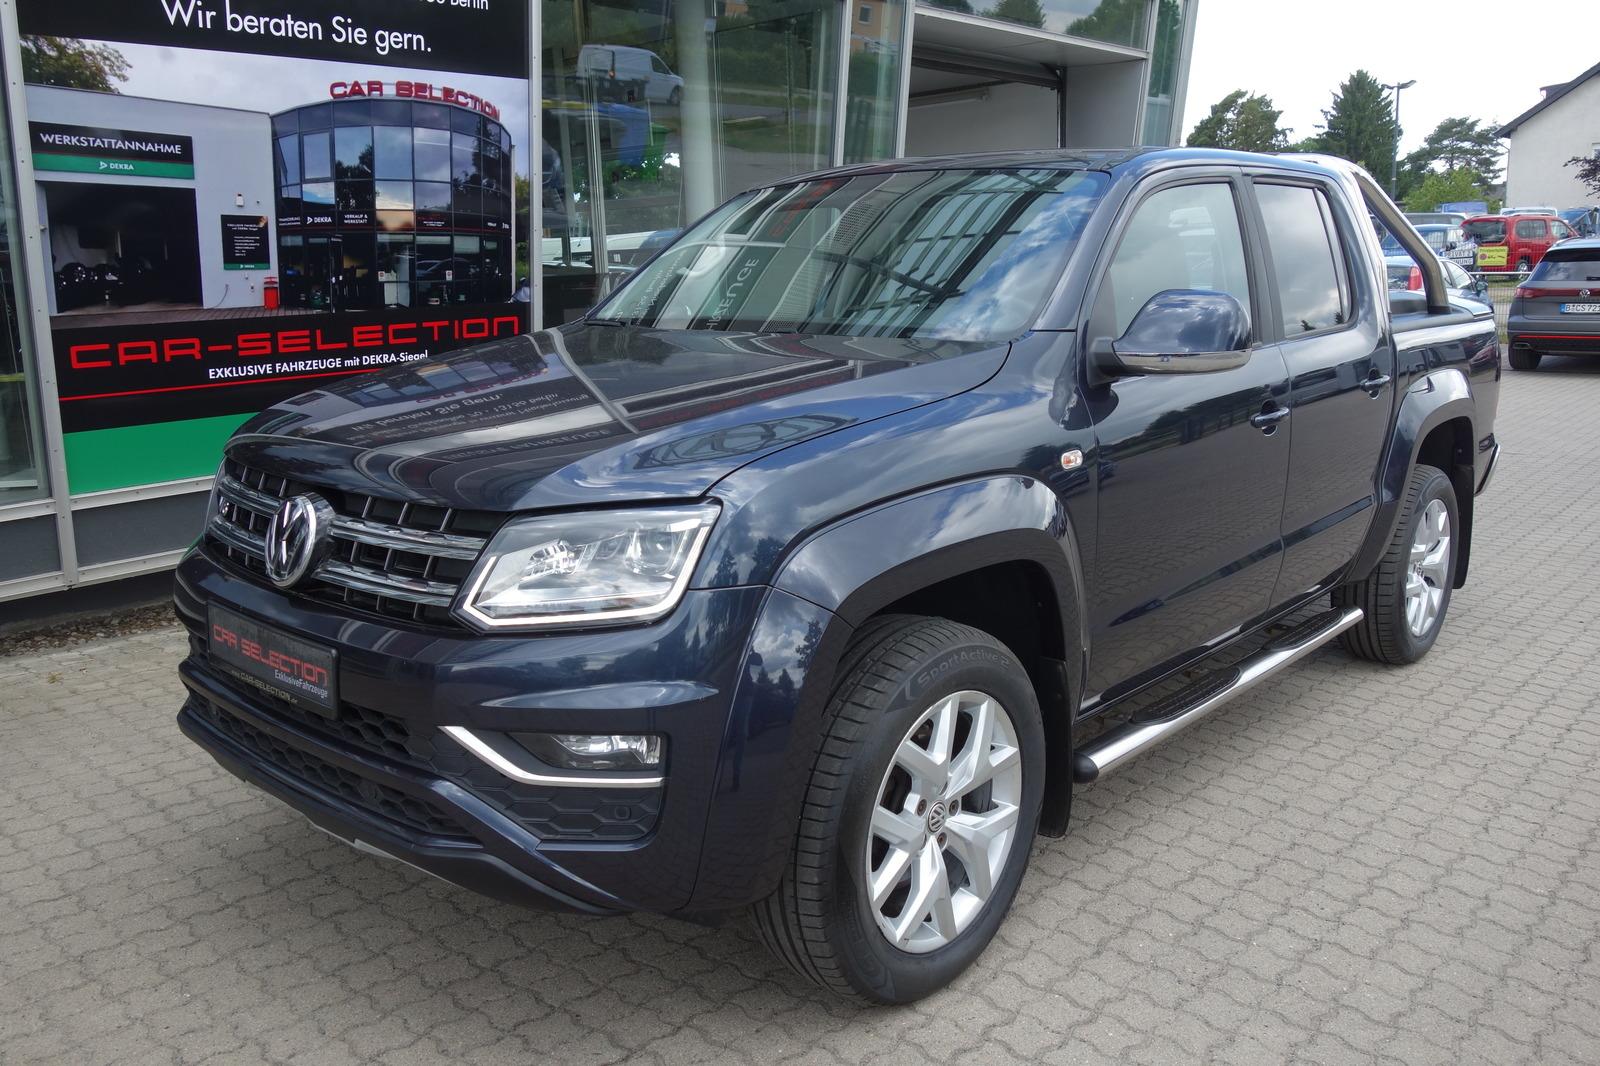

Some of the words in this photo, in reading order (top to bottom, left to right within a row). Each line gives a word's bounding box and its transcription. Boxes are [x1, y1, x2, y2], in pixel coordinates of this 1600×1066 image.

[160, 0, 217, 29] Wir
[225, 0, 323, 41] beraten
[331, 15, 367, 46] Sie
[374, 28, 432, 56] gern.
[329, 80, 384, 100] CAR
[39, 132, 182, 155] WERKSTATTANNAHME
[109, 162, 134, 171] DEKRA
[208, 364, 273, 380] EXKLUSIVE
[275, 357, 342, 374] FAHRZEUGE
[344, 356, 360, 367] mit
[213, 624, 238, 649] CAR
[240, 637, 328, 687] SELECTION
